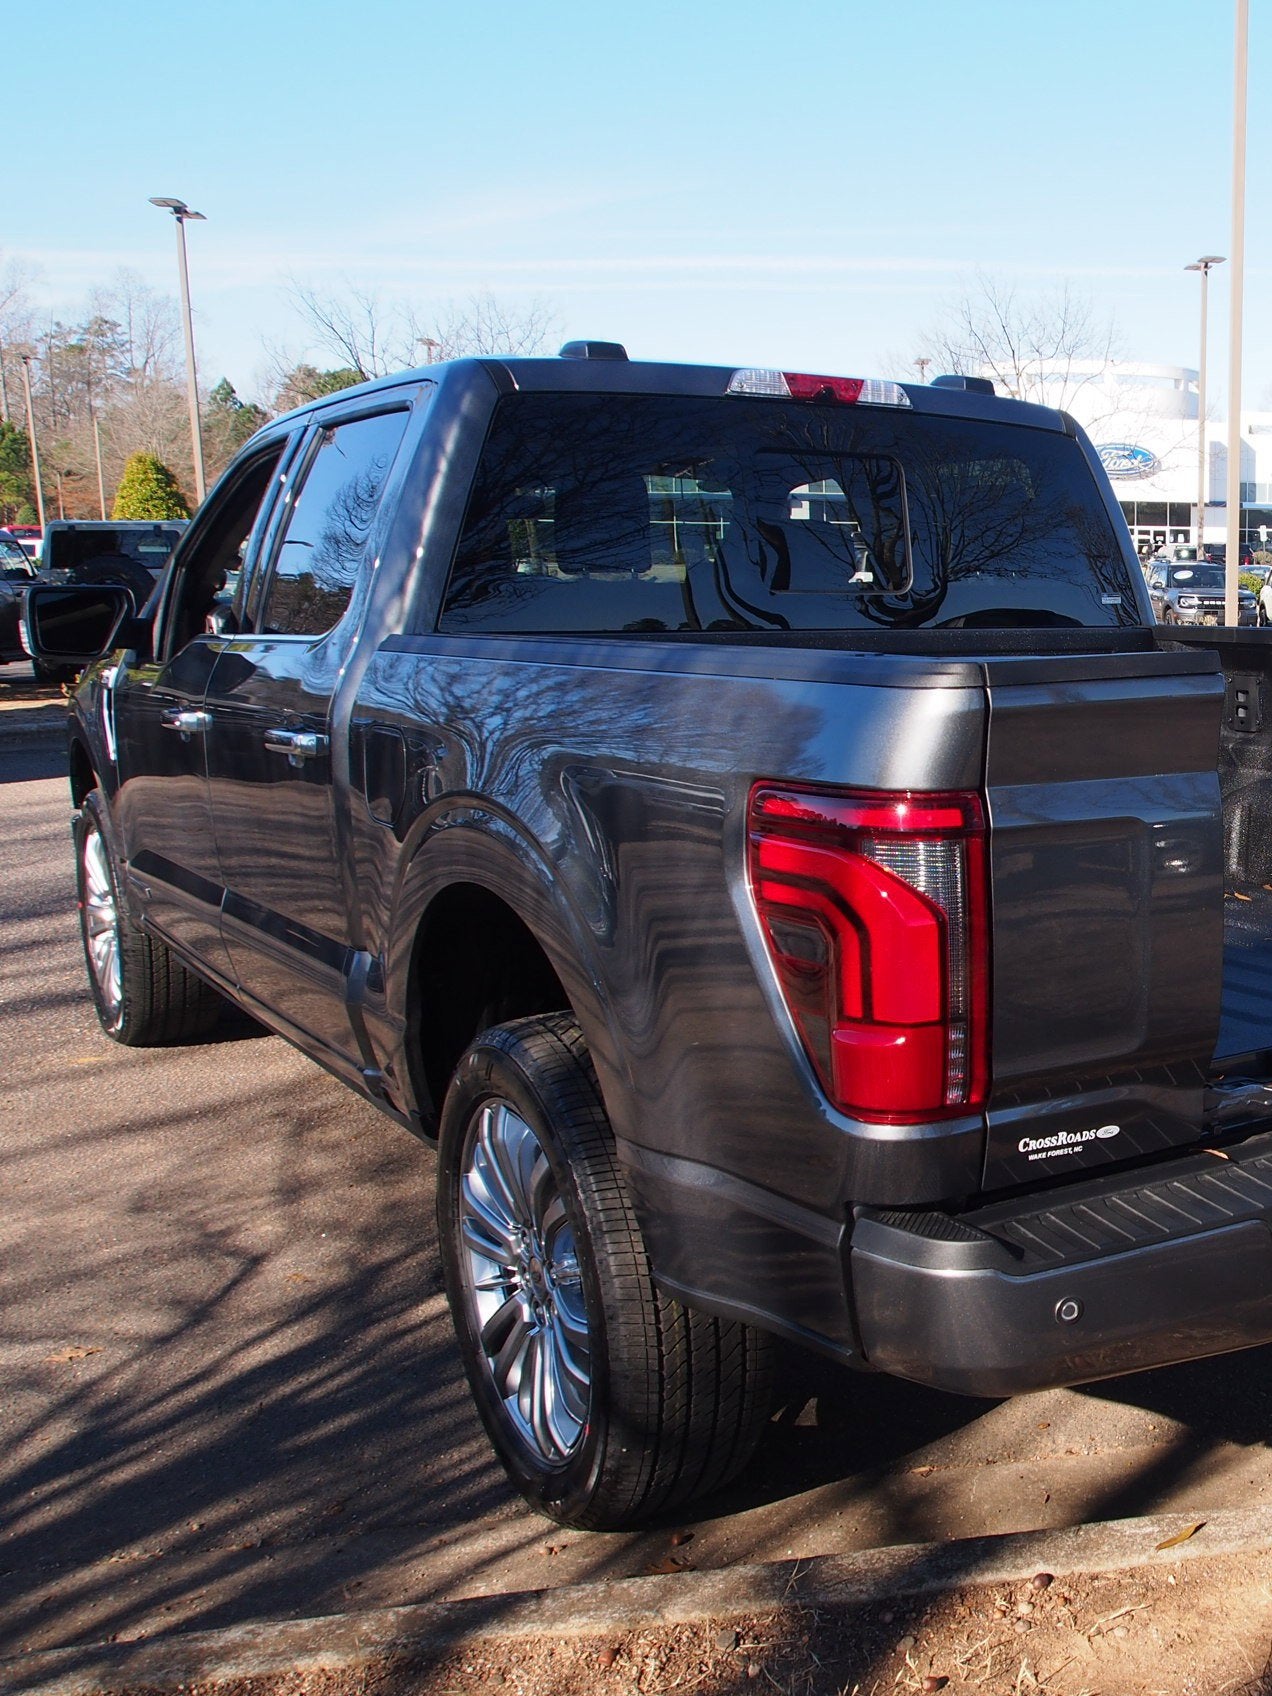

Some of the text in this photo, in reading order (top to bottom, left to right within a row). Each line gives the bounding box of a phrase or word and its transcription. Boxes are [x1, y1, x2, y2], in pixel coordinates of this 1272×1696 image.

[1100, 449, 1144, 469] Ford
[1028, 1145, 1083, 1161] WAKE FOREST, NC
